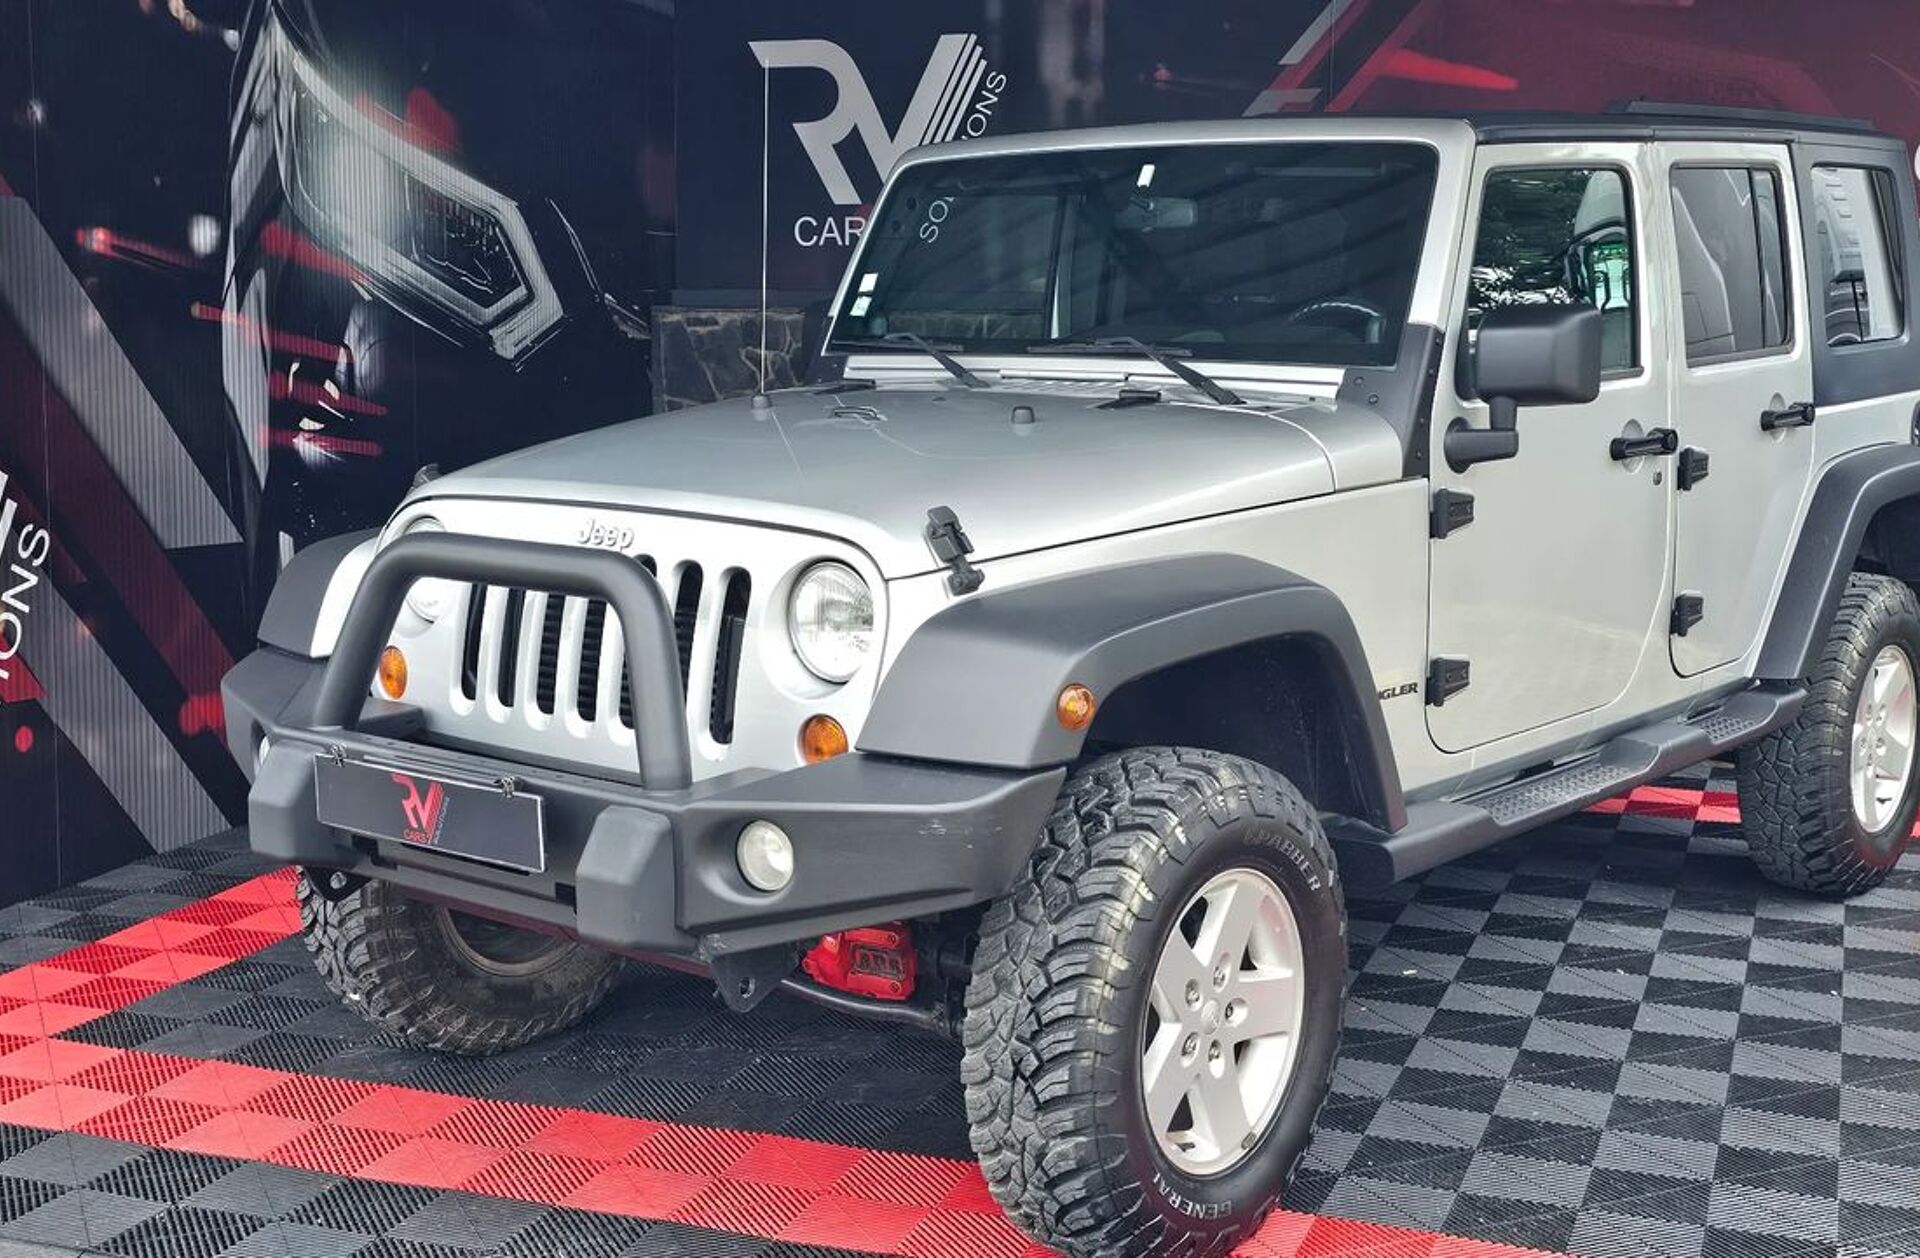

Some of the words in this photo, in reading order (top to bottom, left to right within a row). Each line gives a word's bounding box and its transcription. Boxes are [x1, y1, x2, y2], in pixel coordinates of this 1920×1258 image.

[794, 215, 867, 247] CAR
[576, 517, 635, 553] Jeep
[1152, 1163, 1232, 1219] GENERAL
